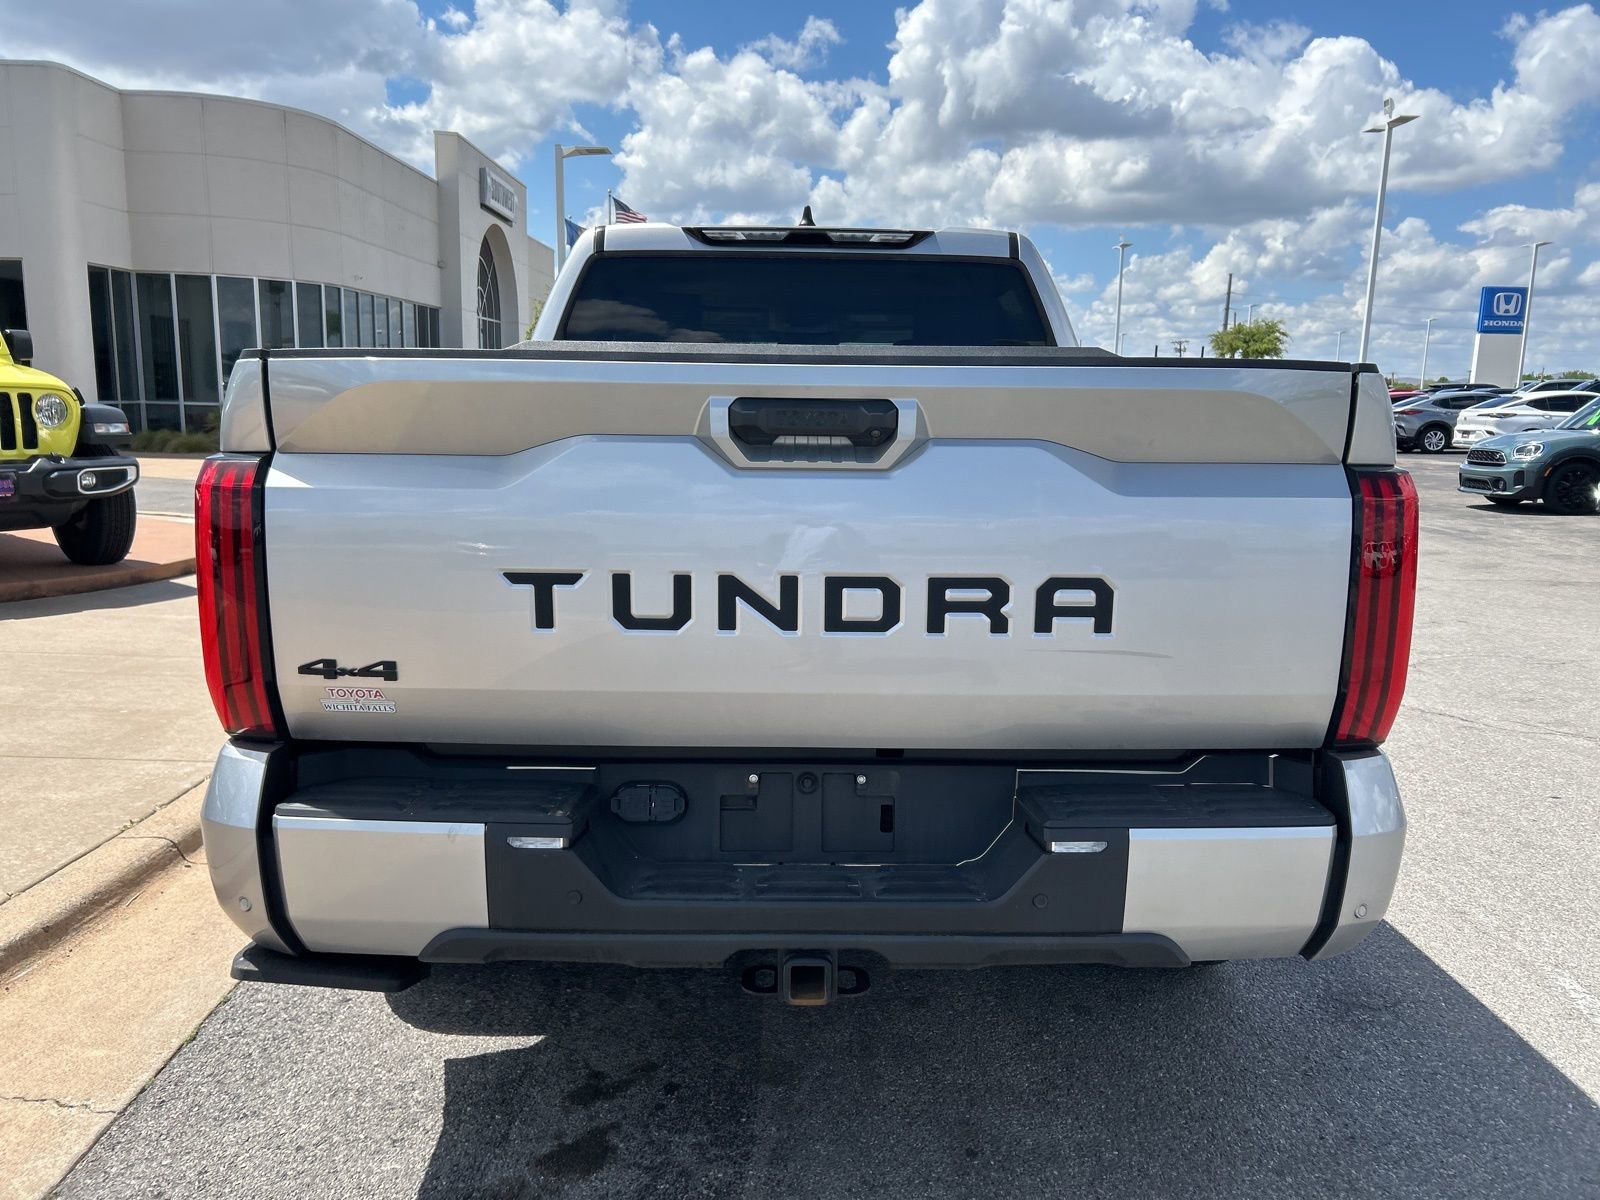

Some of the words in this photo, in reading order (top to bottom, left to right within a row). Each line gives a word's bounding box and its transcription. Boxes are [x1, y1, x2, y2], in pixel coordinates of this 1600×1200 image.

[499, 570, 1116, 636] TUNDRA
[327, 688, 384, 699] TOYOTA
[323, 703, 365, 712] WICHITA
[366, 704, 395, 712] FALLS
